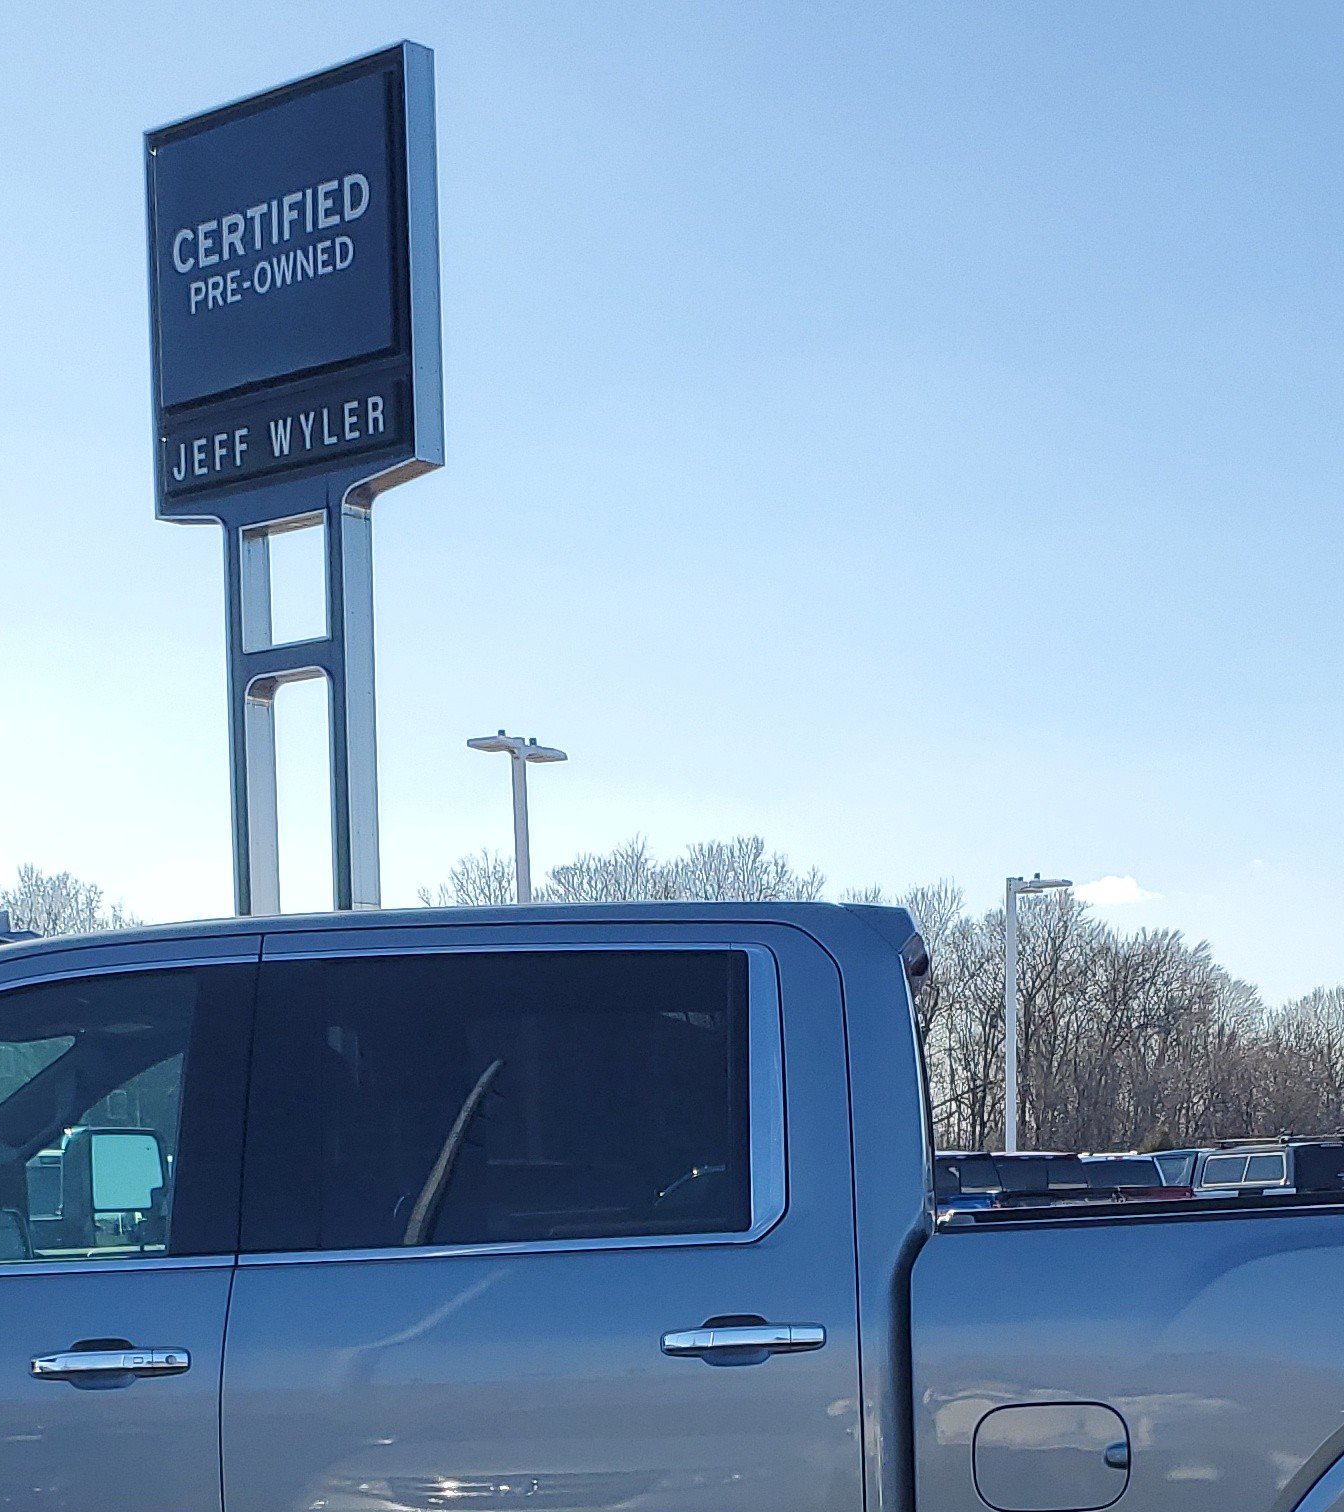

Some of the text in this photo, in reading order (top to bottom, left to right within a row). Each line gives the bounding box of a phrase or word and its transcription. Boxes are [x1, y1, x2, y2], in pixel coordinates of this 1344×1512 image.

[172, 172, 371, 275] CERTIFIED
[189, 235, 355, 315] PRE-OWNED
[172, 395, 386, 482] JEFF WYLER
